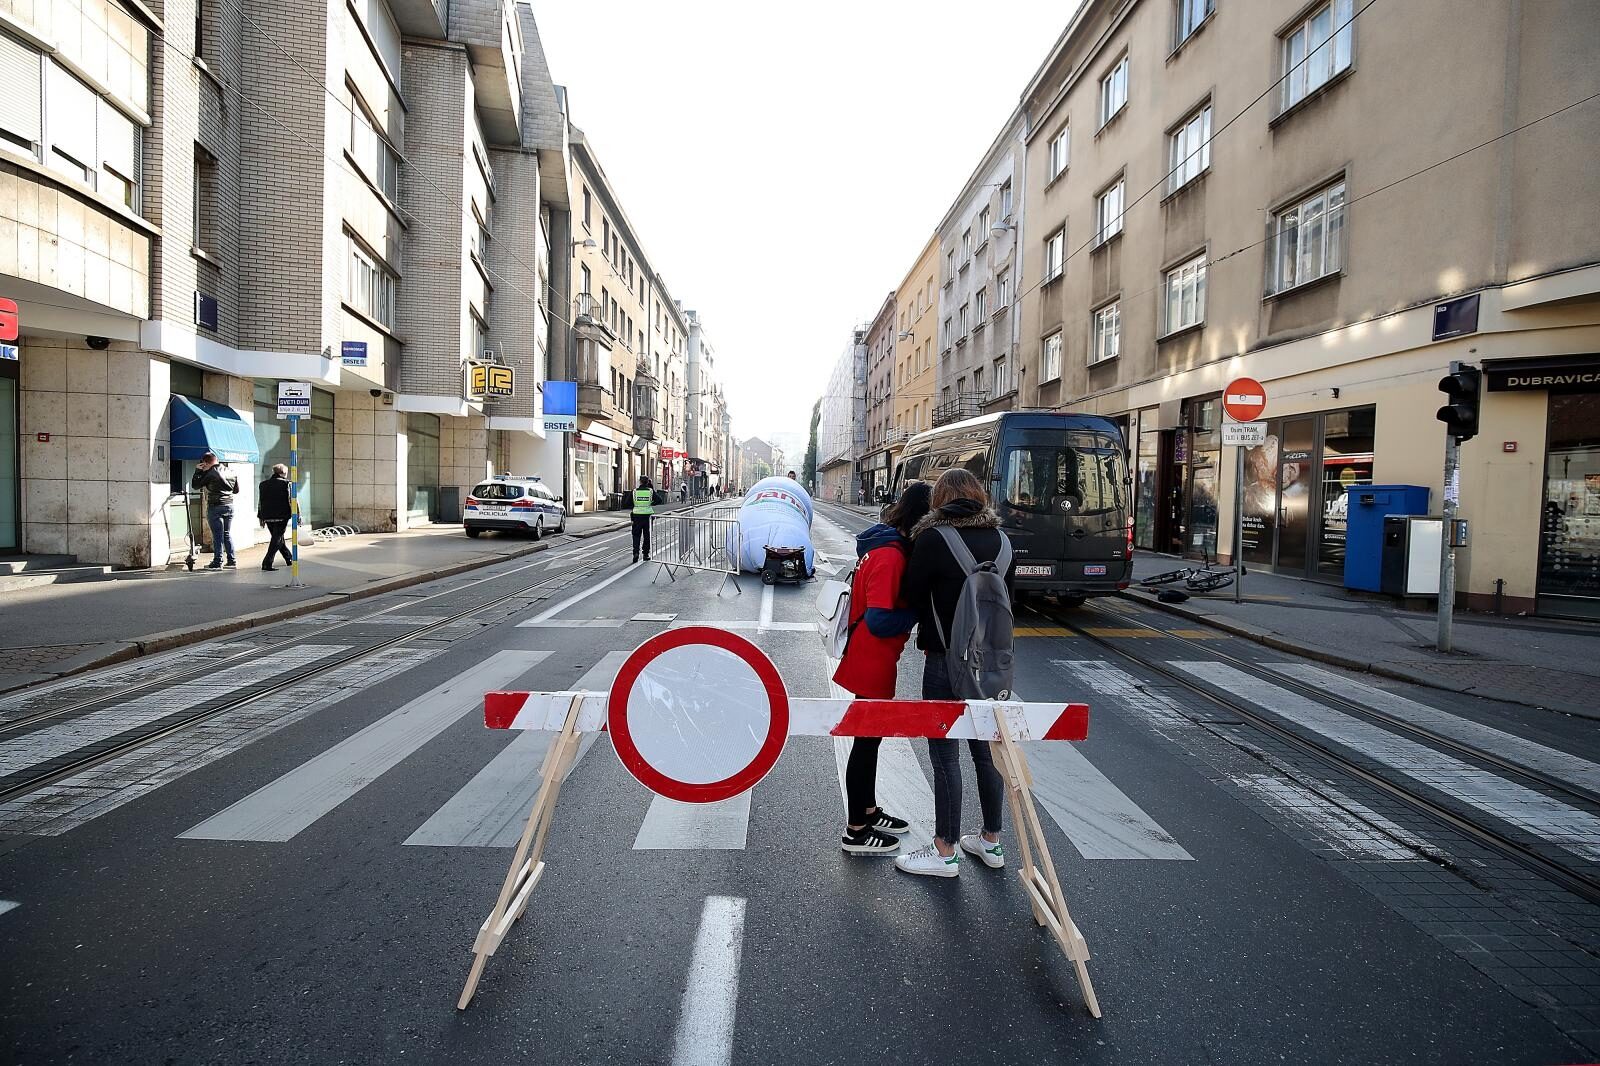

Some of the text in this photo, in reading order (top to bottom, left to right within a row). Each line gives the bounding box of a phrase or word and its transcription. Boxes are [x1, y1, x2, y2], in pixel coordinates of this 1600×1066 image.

[1507, 374, 1600, 387] DUBRAVICA
[489, 386, 511, 395] RETEL
[544, 422, 568, 430] ERSTE
